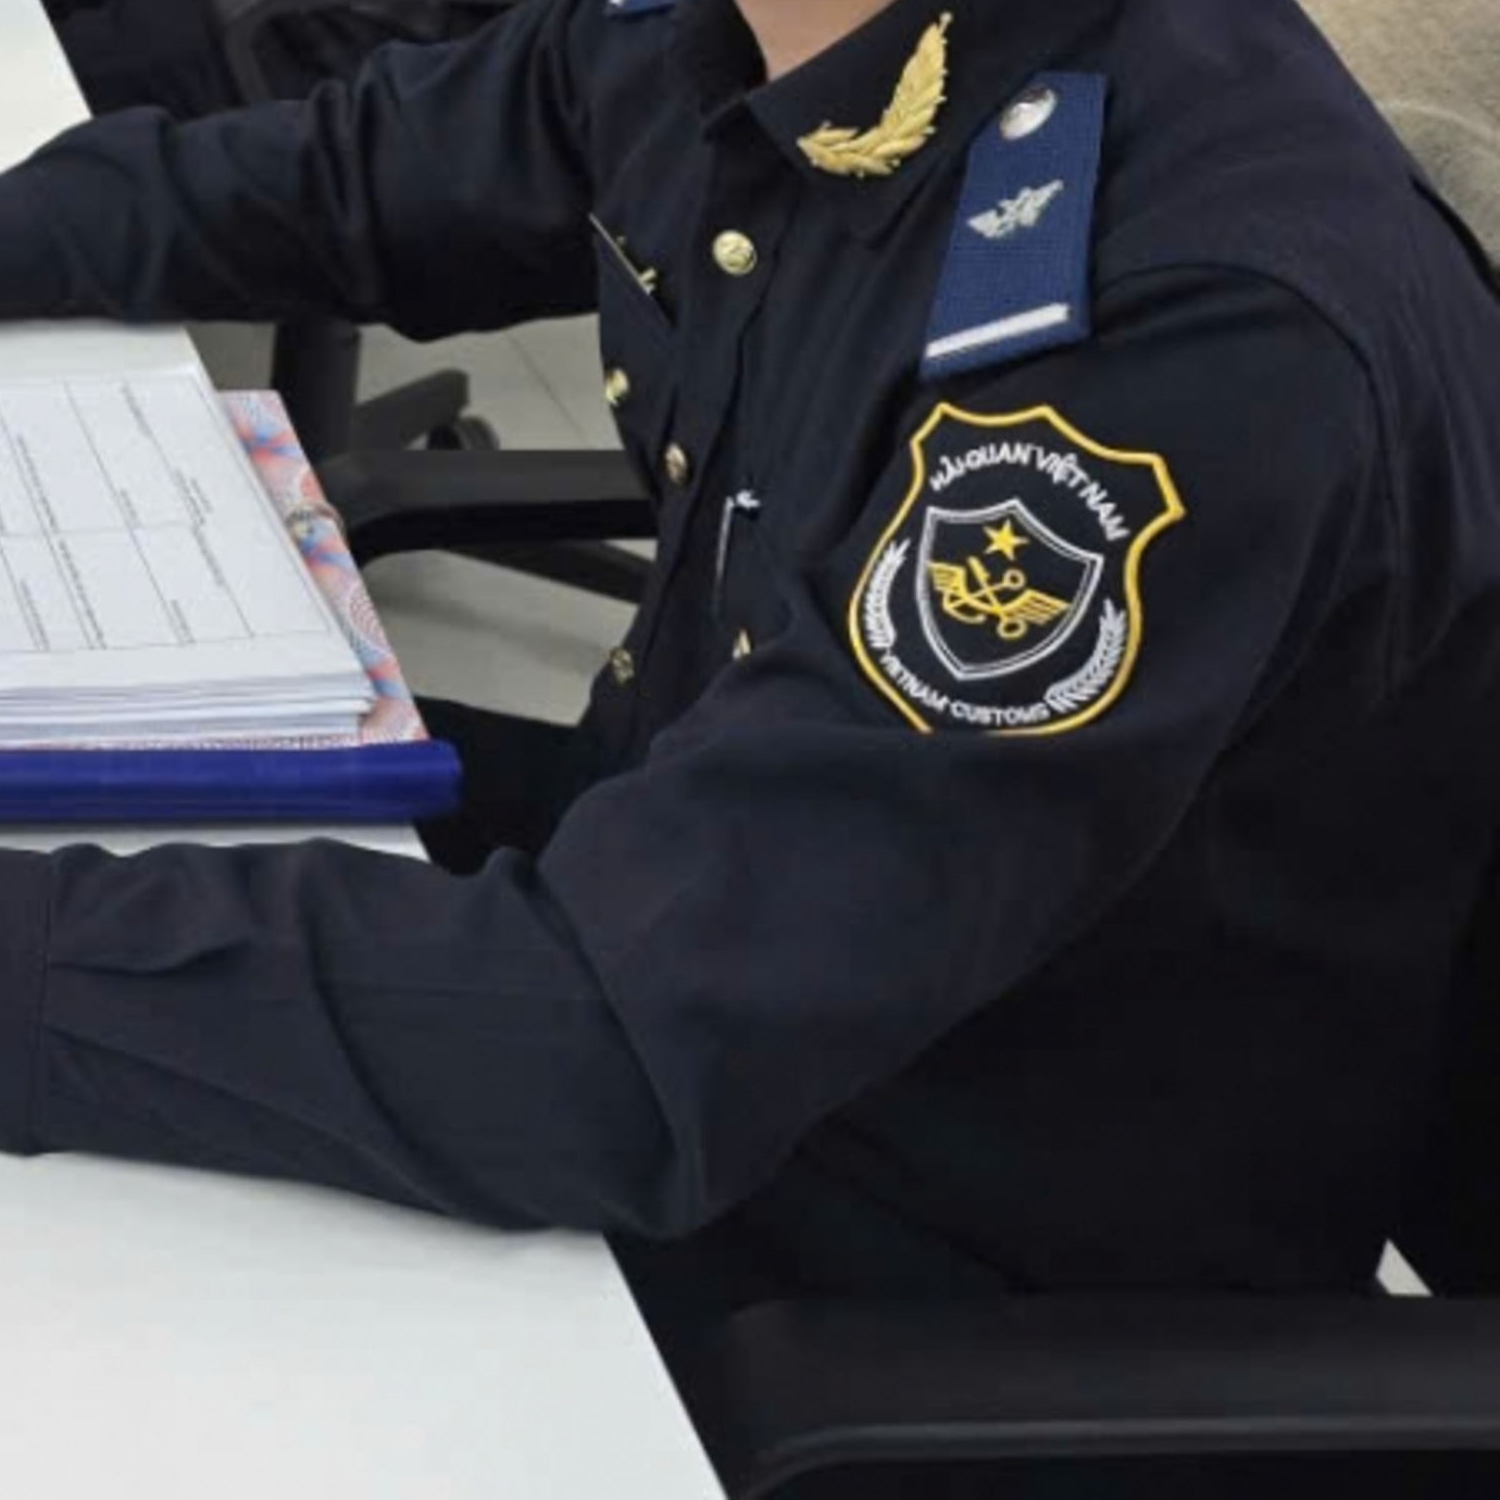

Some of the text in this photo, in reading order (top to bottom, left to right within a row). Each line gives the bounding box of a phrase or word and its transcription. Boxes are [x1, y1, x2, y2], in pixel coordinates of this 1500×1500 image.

[965, 441, 1031, 470] QUAN
[1077, 481, 1131, 541] NAM
[950, 699, 1051, 725] CUSTOMS
